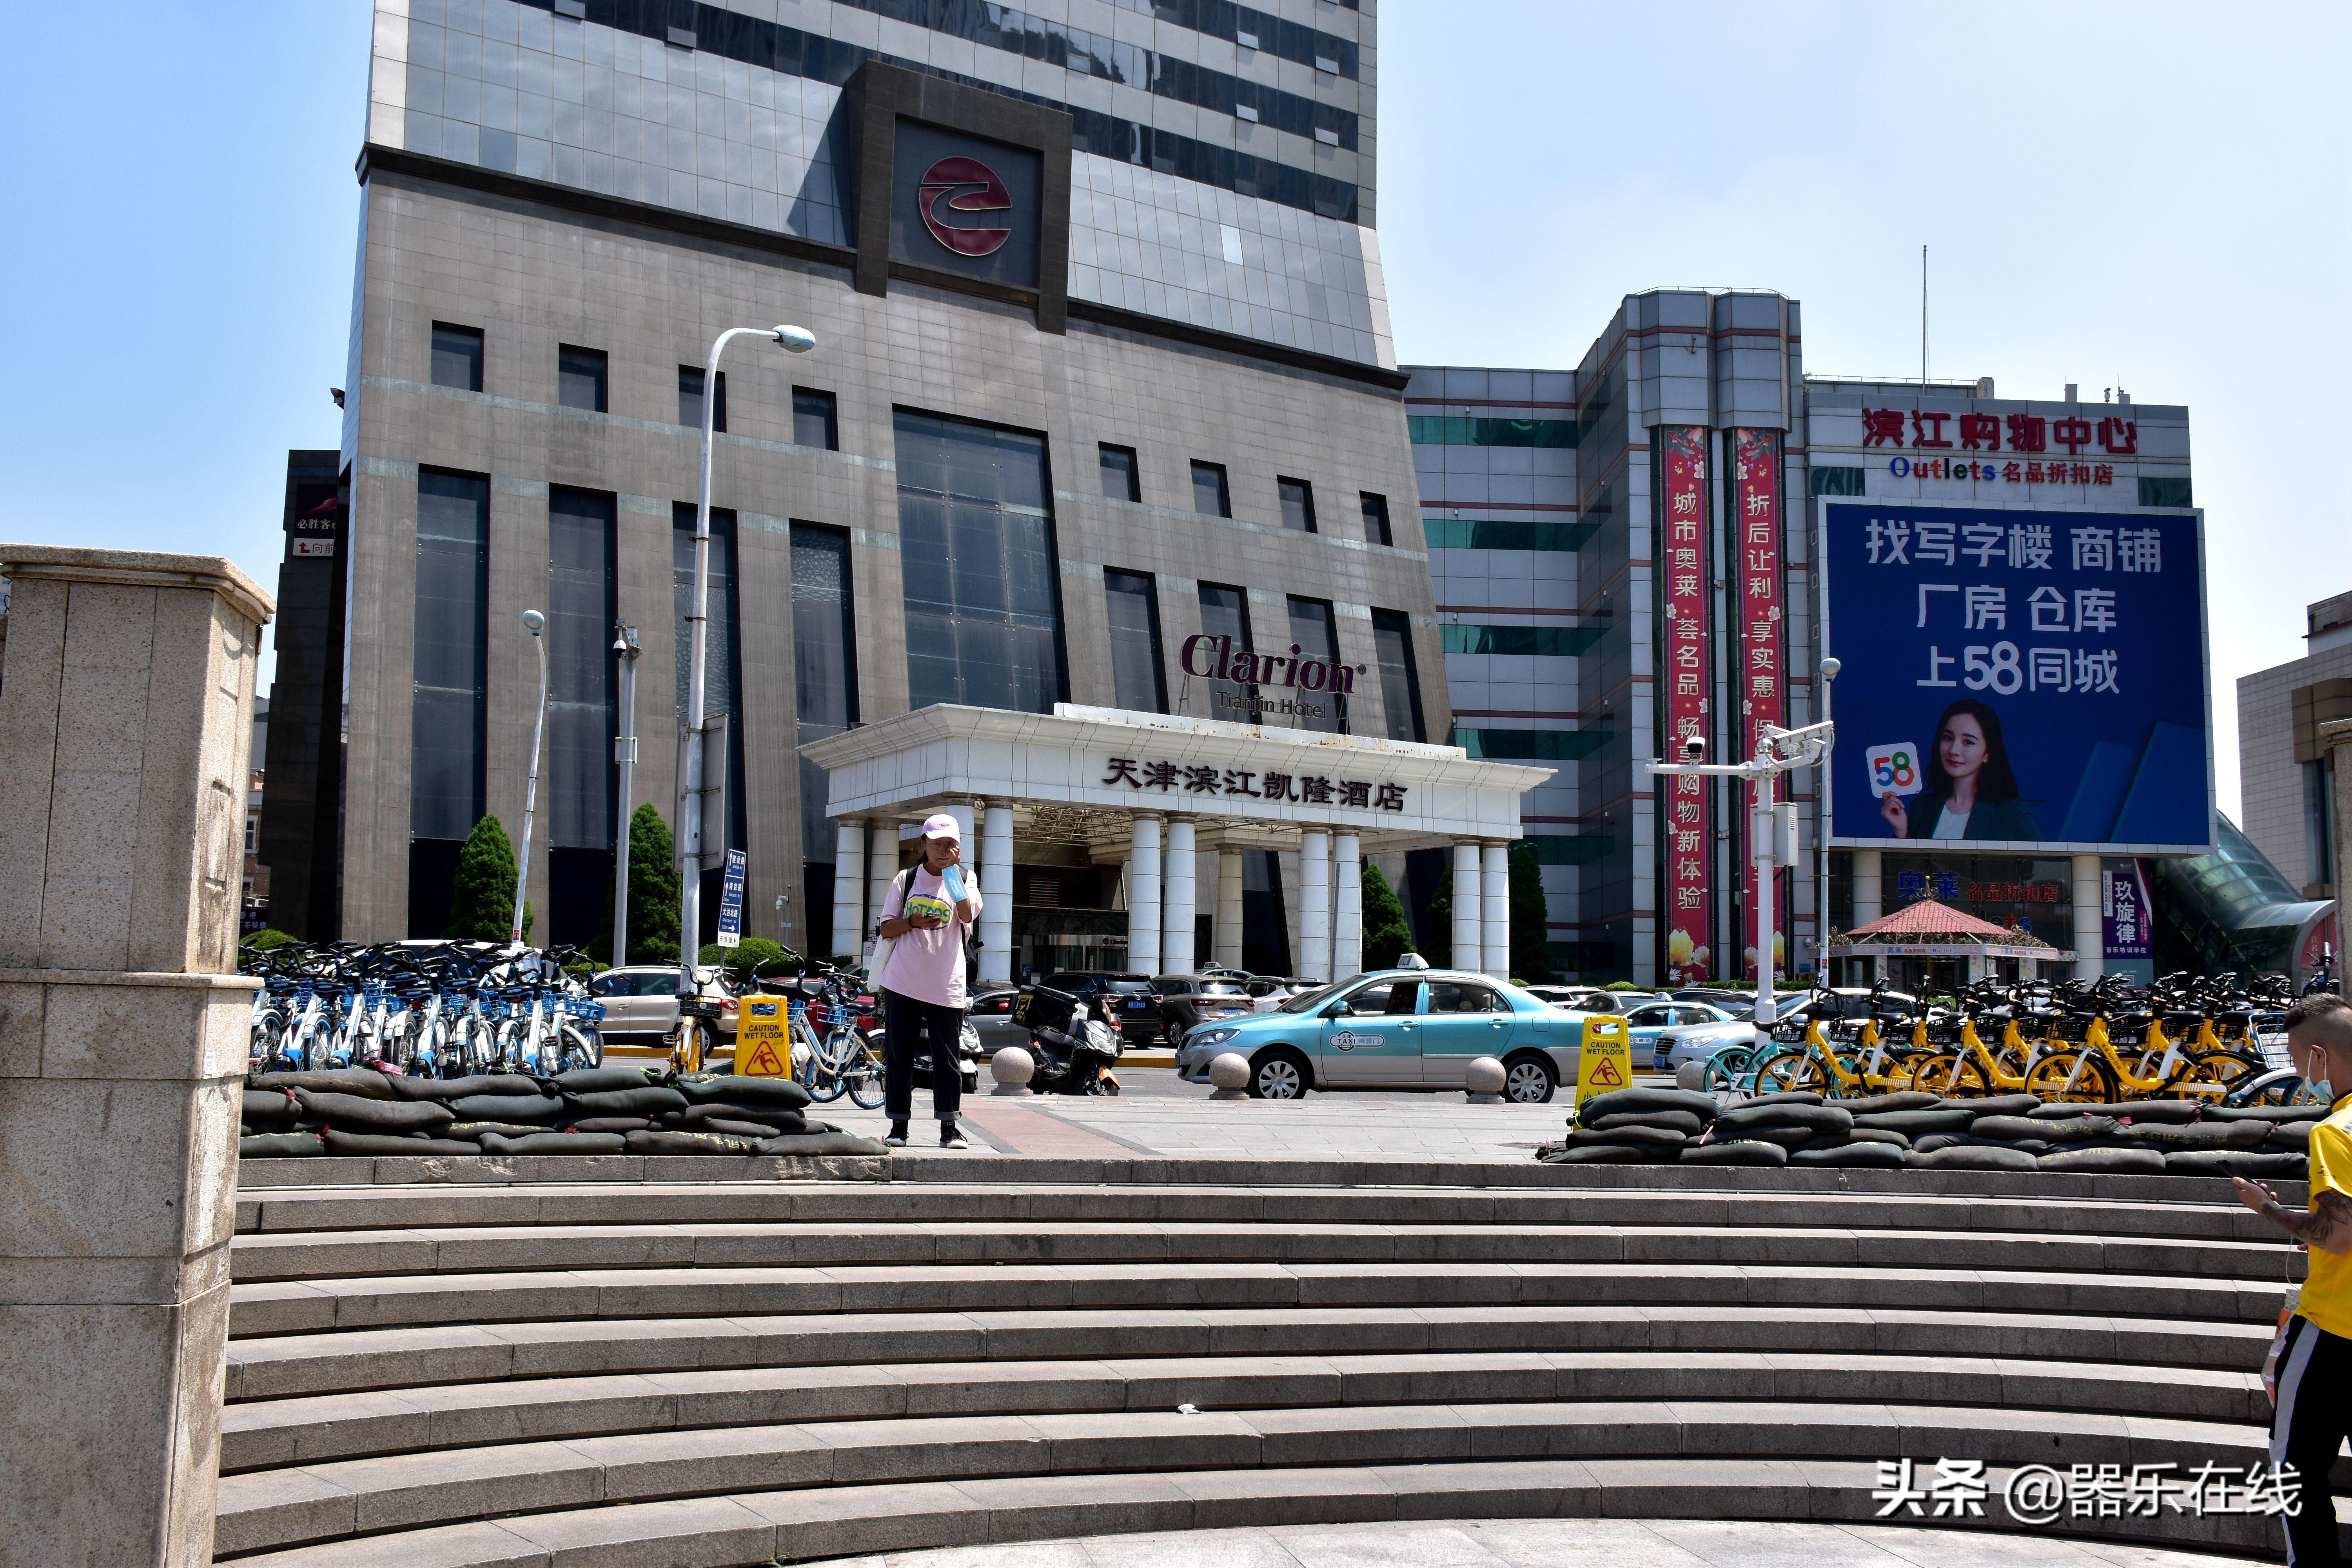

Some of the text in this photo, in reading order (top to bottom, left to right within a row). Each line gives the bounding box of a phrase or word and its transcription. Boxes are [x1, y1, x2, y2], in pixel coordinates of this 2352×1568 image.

[1863, 407, 2137, 455] 滨江购物中心
[1889, 456, 2113, 485] Outlets 名品折扣店
[1673, 492, 1698, 597] 城市奥莱
[1746, 494, 1772, 599] 折后让利
[1866, 519, 2161, 573] 找写字楼 商铺
[1916, 583, 2116, 633] 厂房 仓库
[1180, 634, 1354, 695] Clarion
[1676, 617, 1699, 696] 荟名品
[1751, 619, 1775, 698] 享实惠
[1916, 641, 2120, 695] 上58同城
[1216, 691, 1326, 719] Tianjin Hotel
[1102, 757, 1408, 812] 天津滨江凯隆酒店
[1874, 751, 1915, 787] 58
[1897, 870, 2058, 902] 奥莱 名品折扣店
[2114, 881, 2136, 943] 玖旋律
